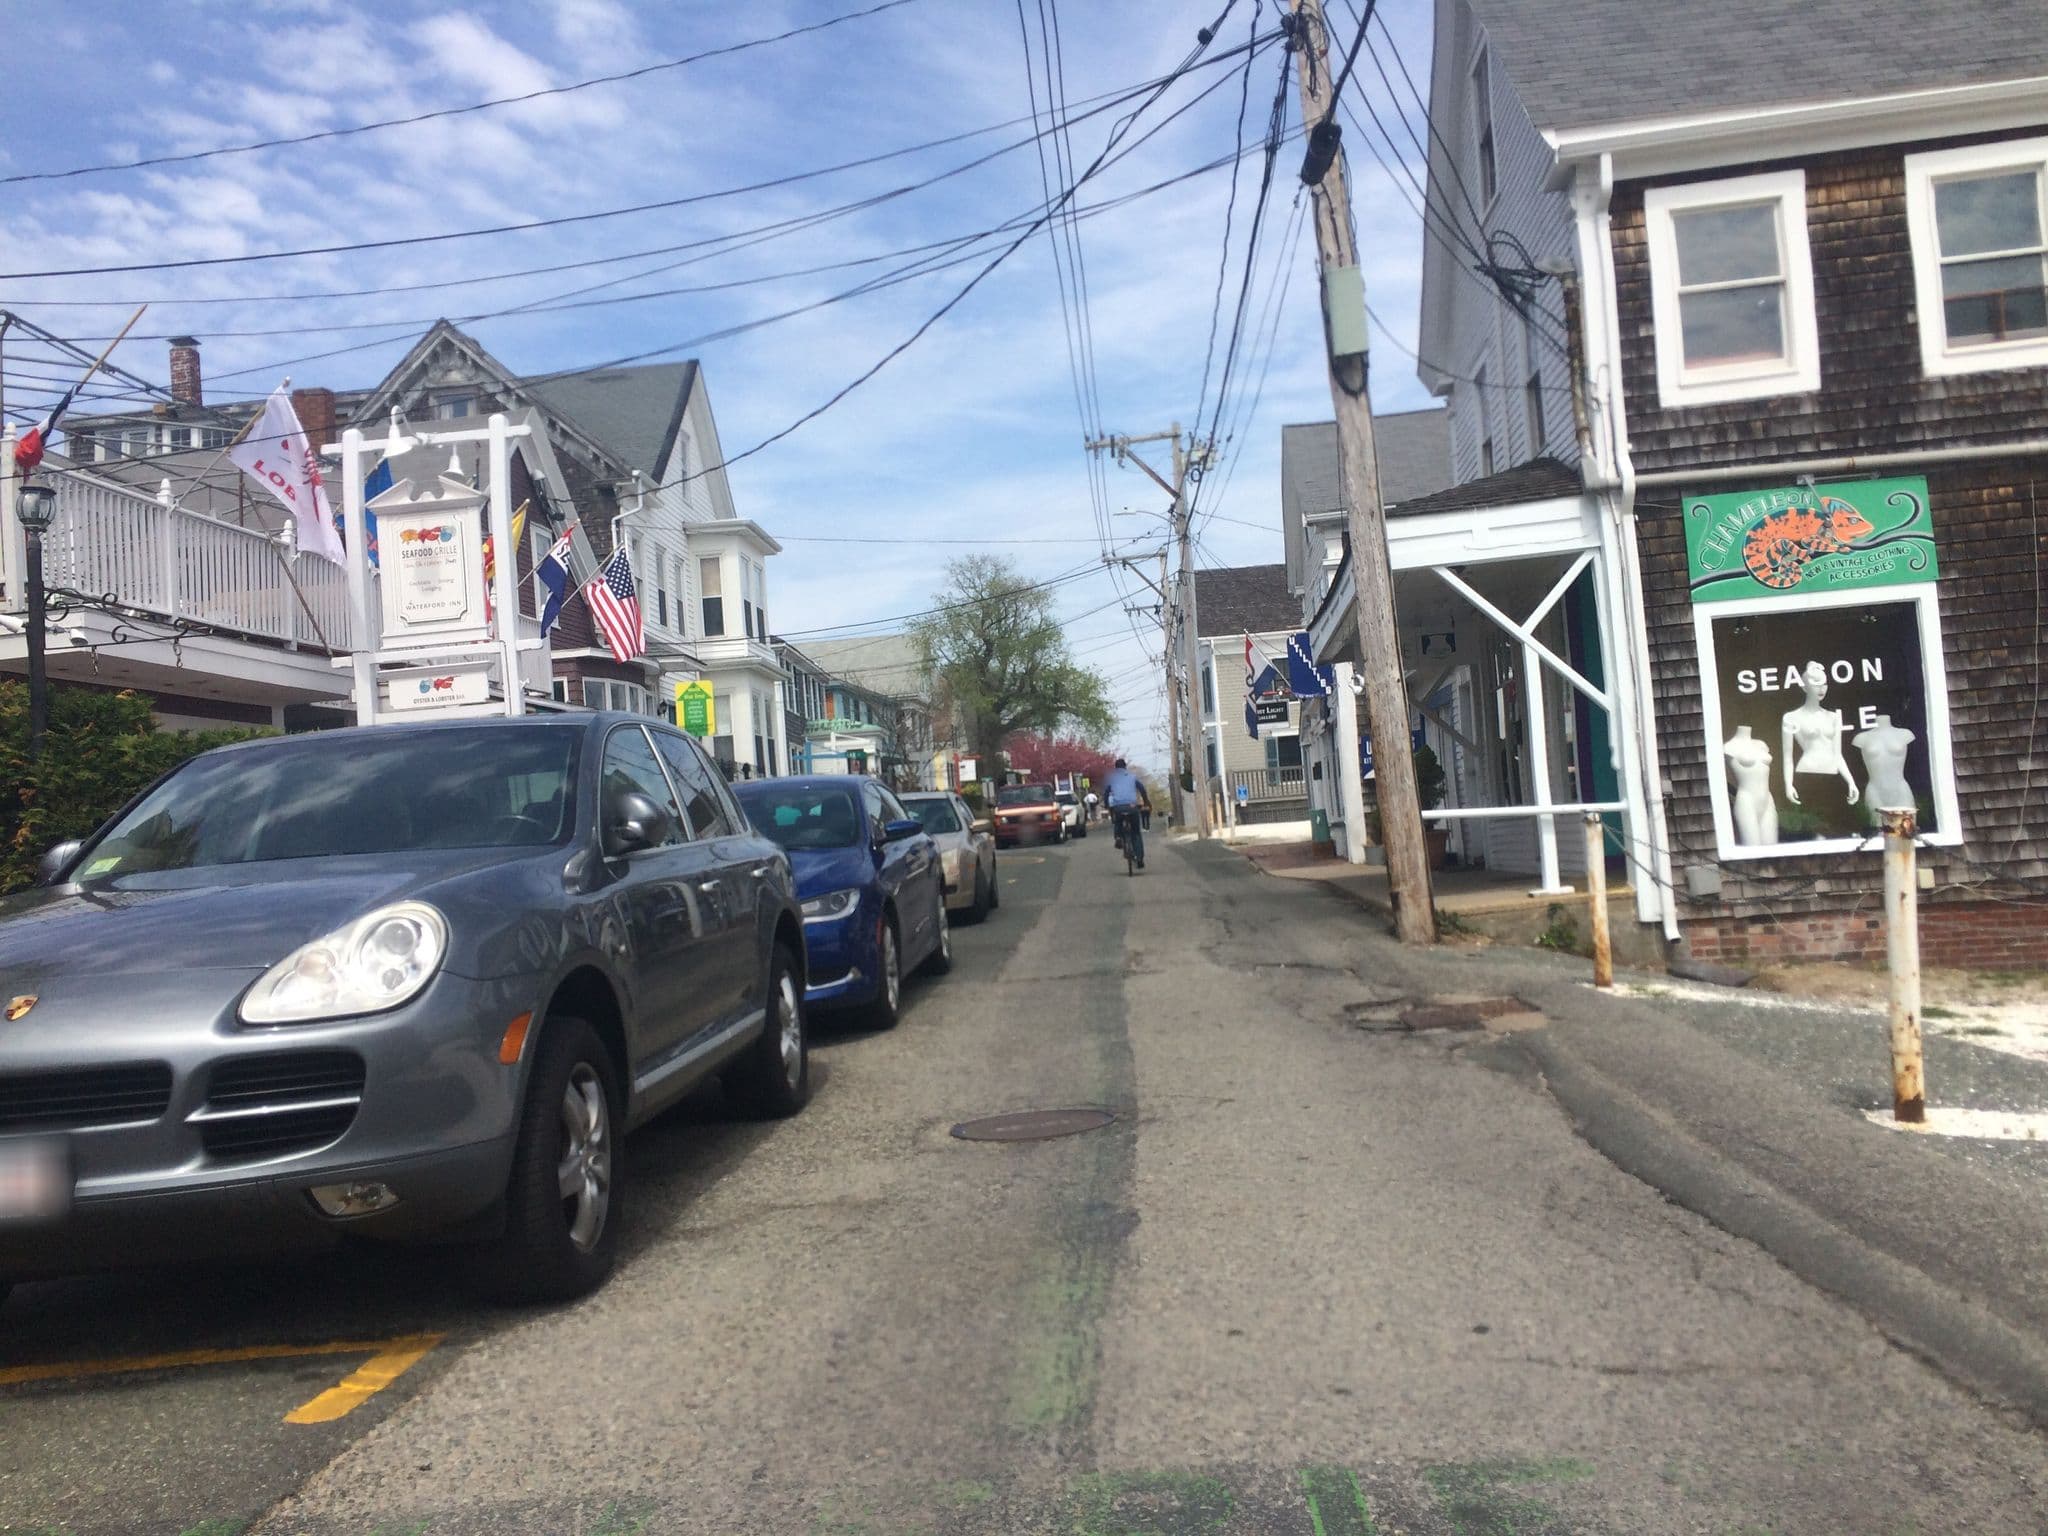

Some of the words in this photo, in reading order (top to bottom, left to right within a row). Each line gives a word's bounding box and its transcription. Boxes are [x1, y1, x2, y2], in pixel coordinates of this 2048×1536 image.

[1699, 491, 1815, 570] CHAMELEON
[402, 547, 433, 559] SEAFOOD
[434, 545, 457, 556] GRILLE
[1805, 565, 1822, 579] NEW
[1830, 557, 1865, 569] VINTAGE
[1867, 547, 1911, 563] CLOTHING
[1829, 561, 1896, 582] ACCESSORIES
[406, 601, 446, 611] WATERFORD
[1289, 634, 1332, 695] UTILITIES
[1737, 657, 1883, 694] SEASON
